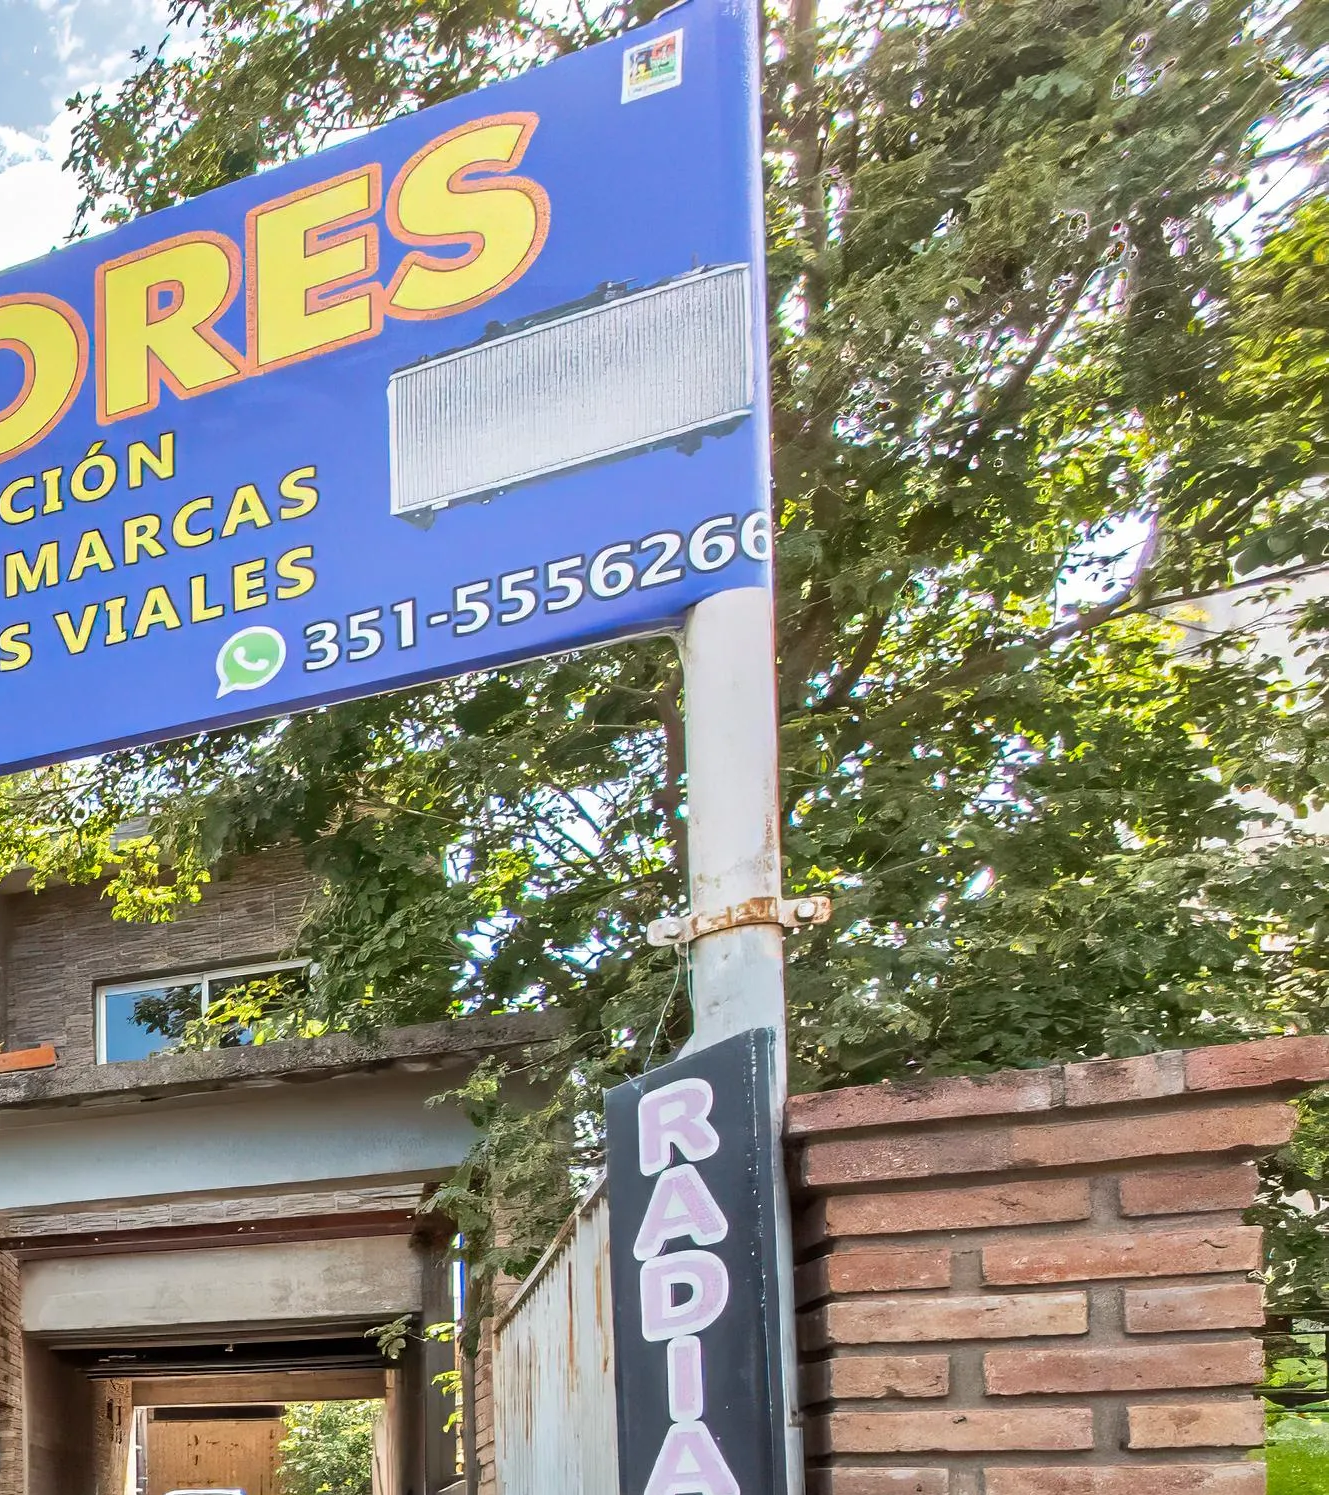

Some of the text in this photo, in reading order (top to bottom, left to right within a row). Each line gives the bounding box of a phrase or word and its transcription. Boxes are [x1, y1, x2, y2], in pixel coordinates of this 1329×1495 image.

[3, 465, 321, 600] MARCAS
[303, 509, 772, 672] 351-5556266
[53, 545, 317, 656] VIALES
